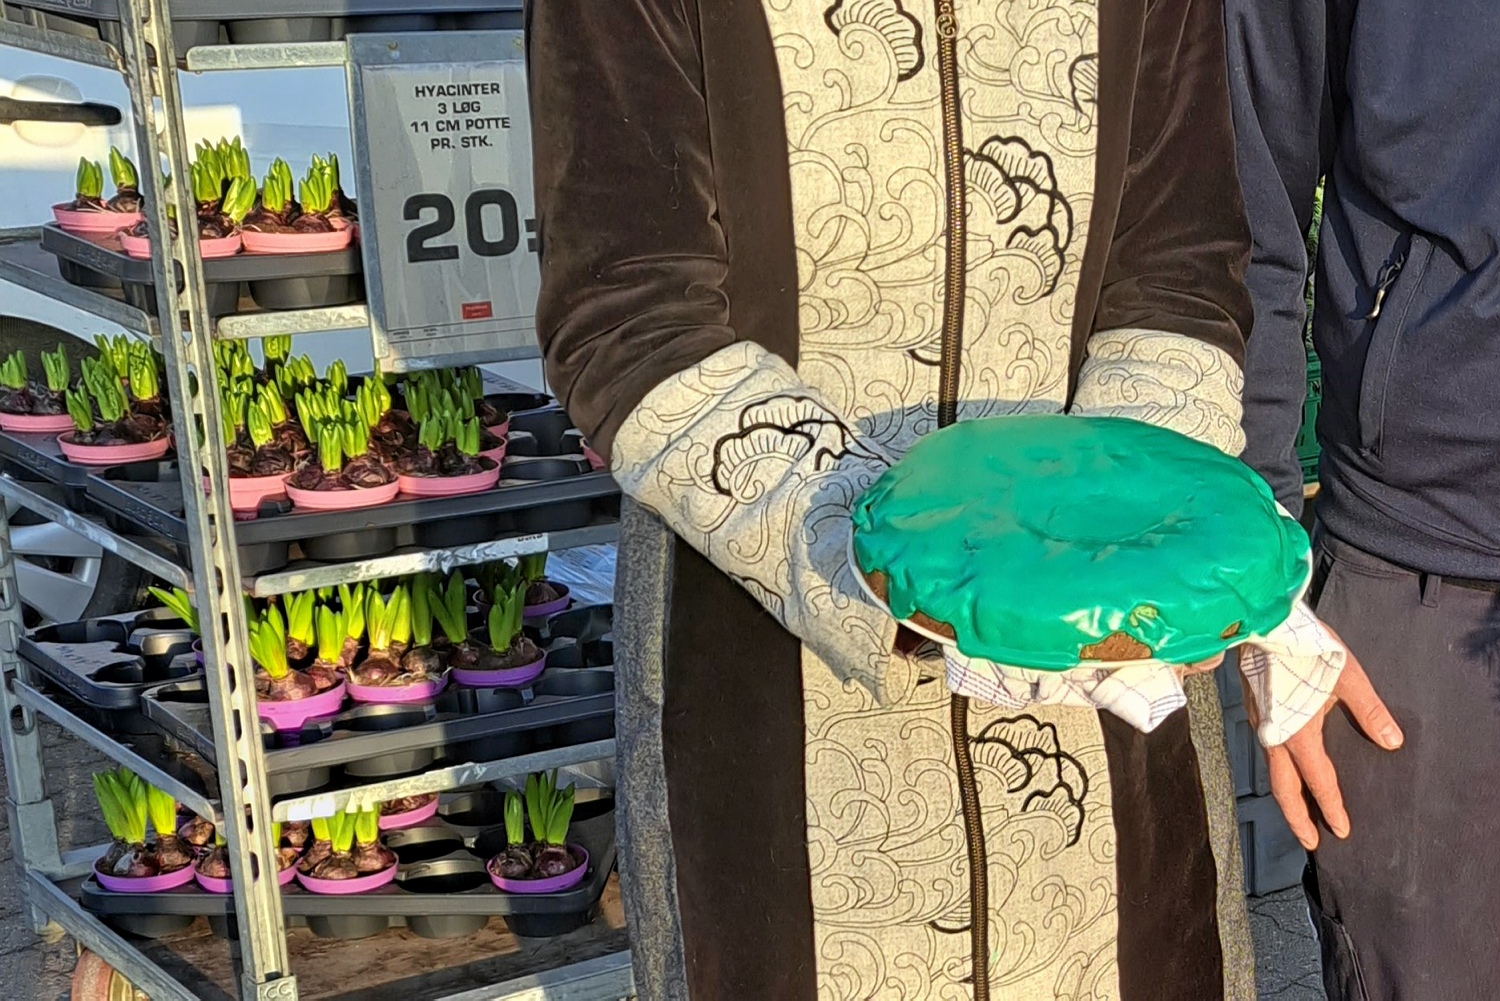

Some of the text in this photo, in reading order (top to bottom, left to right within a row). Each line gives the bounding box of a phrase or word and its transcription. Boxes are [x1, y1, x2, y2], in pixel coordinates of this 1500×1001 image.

[415, 83, 500, 98] HYACINTER
[438, 101, 481, 114] 3 LØG
[410, 116, 511, 133] 11 CM POTTE
[431, 135, 493, 150] PR. STK.
